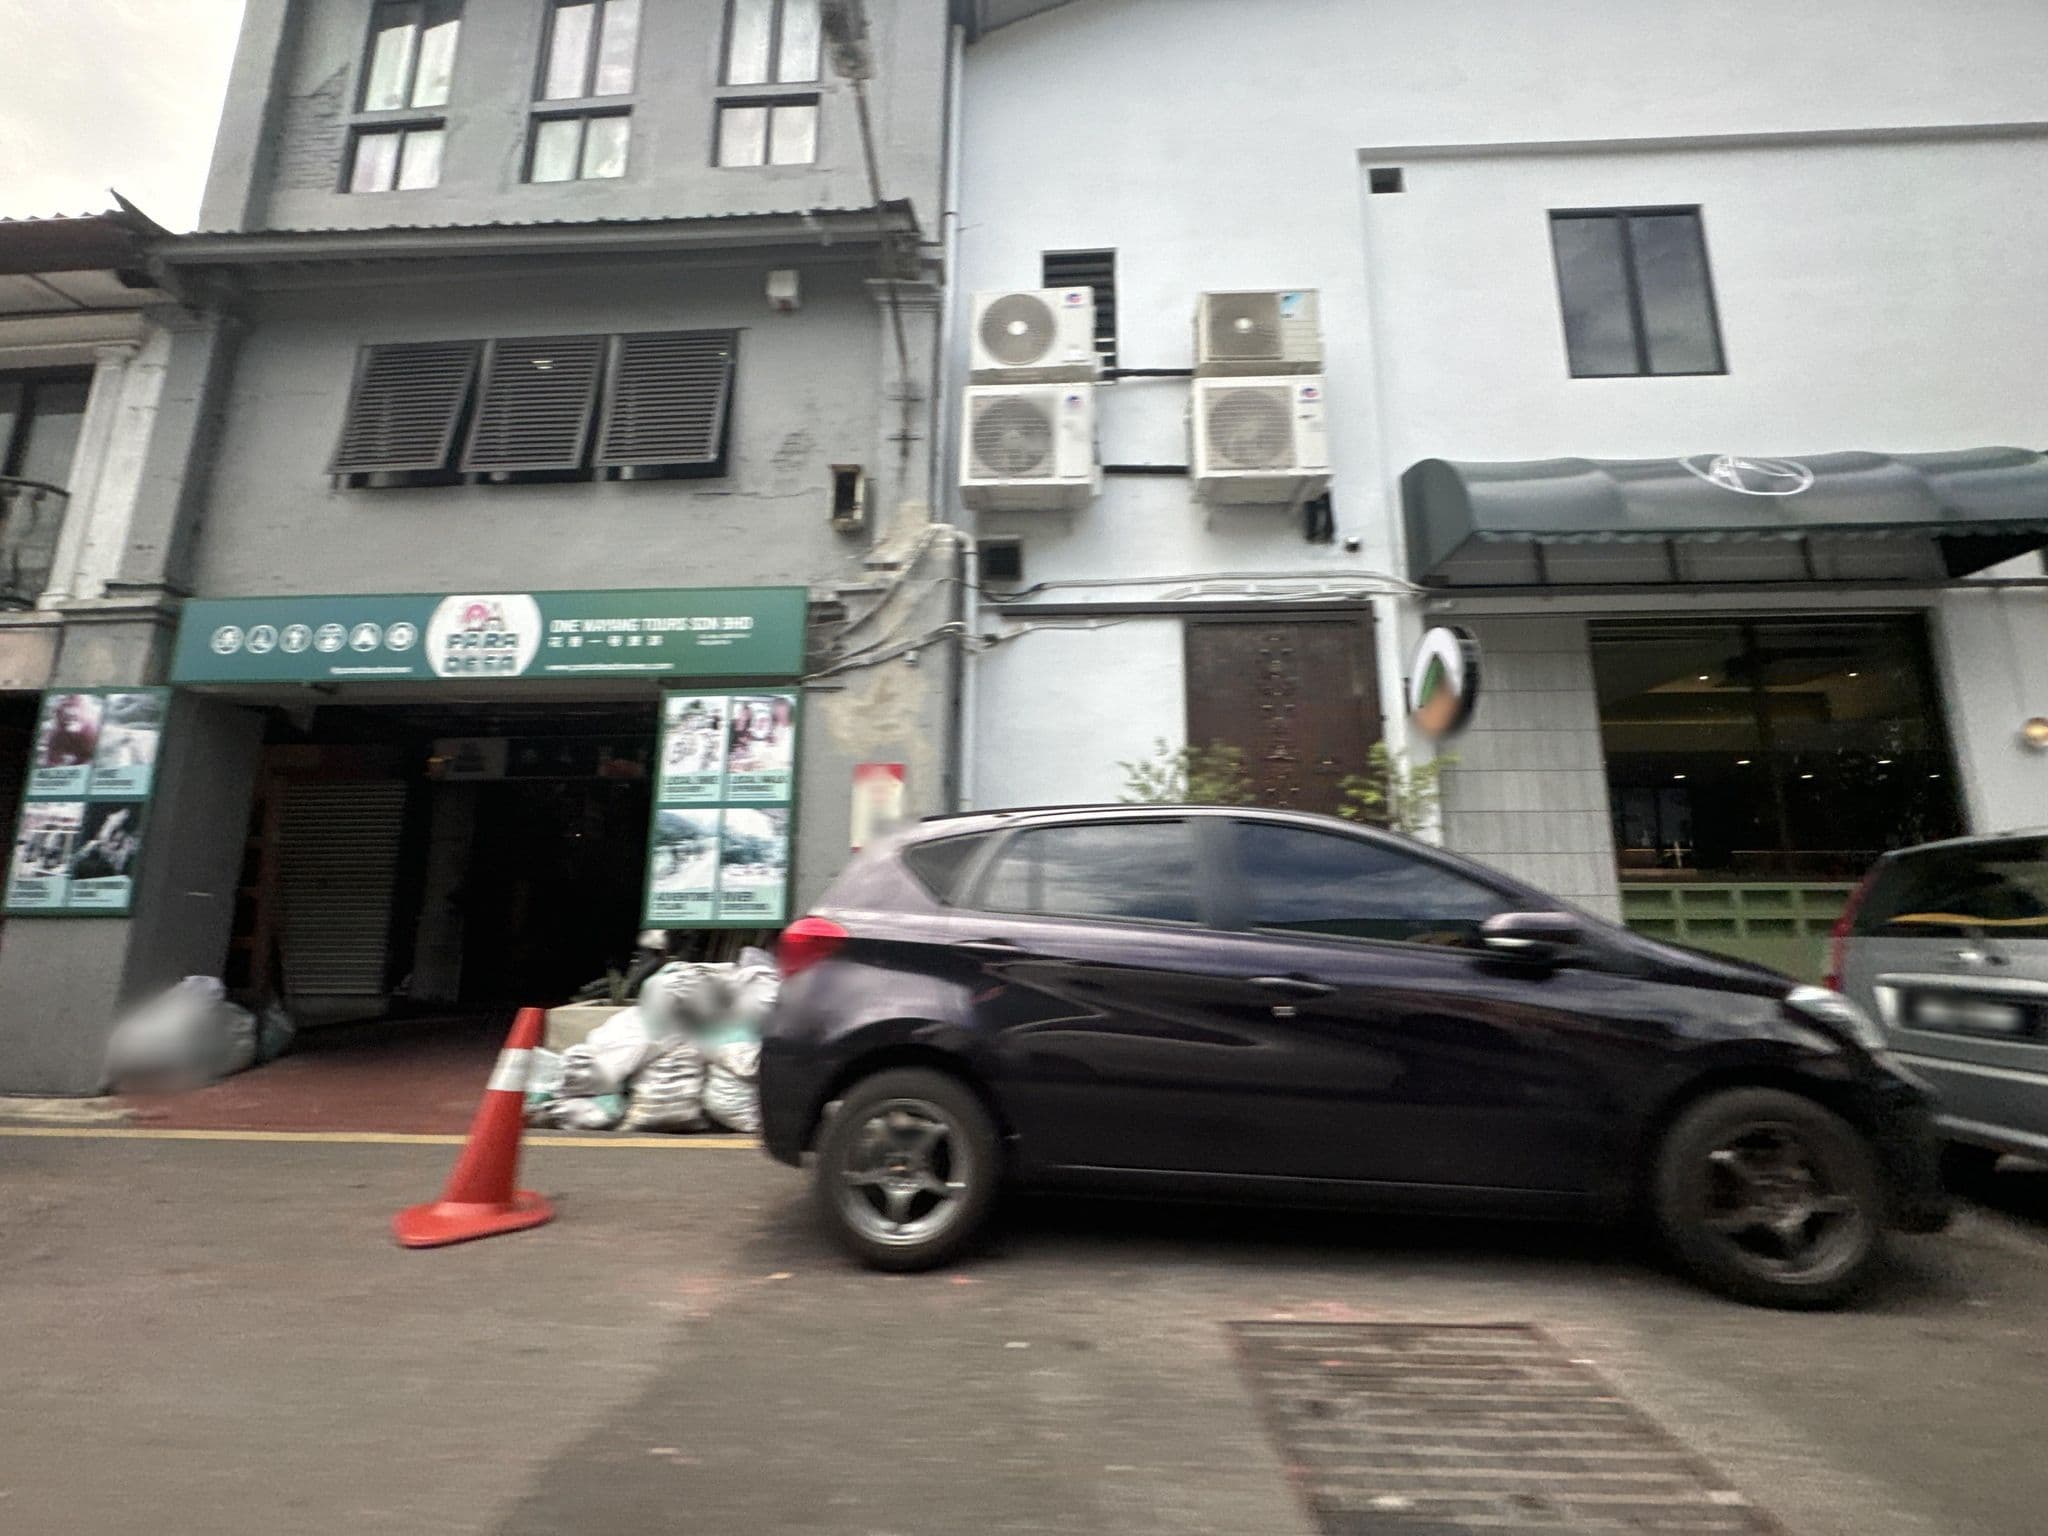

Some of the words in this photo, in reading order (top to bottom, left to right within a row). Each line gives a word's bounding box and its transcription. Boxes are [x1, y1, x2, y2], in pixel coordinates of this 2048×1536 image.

[550, 619, 580, 633] ONE
[643, 617, 687, 631] TOURS
[688, 617, 721, 630] SDN
[724, 616, 754, 630] BHD
